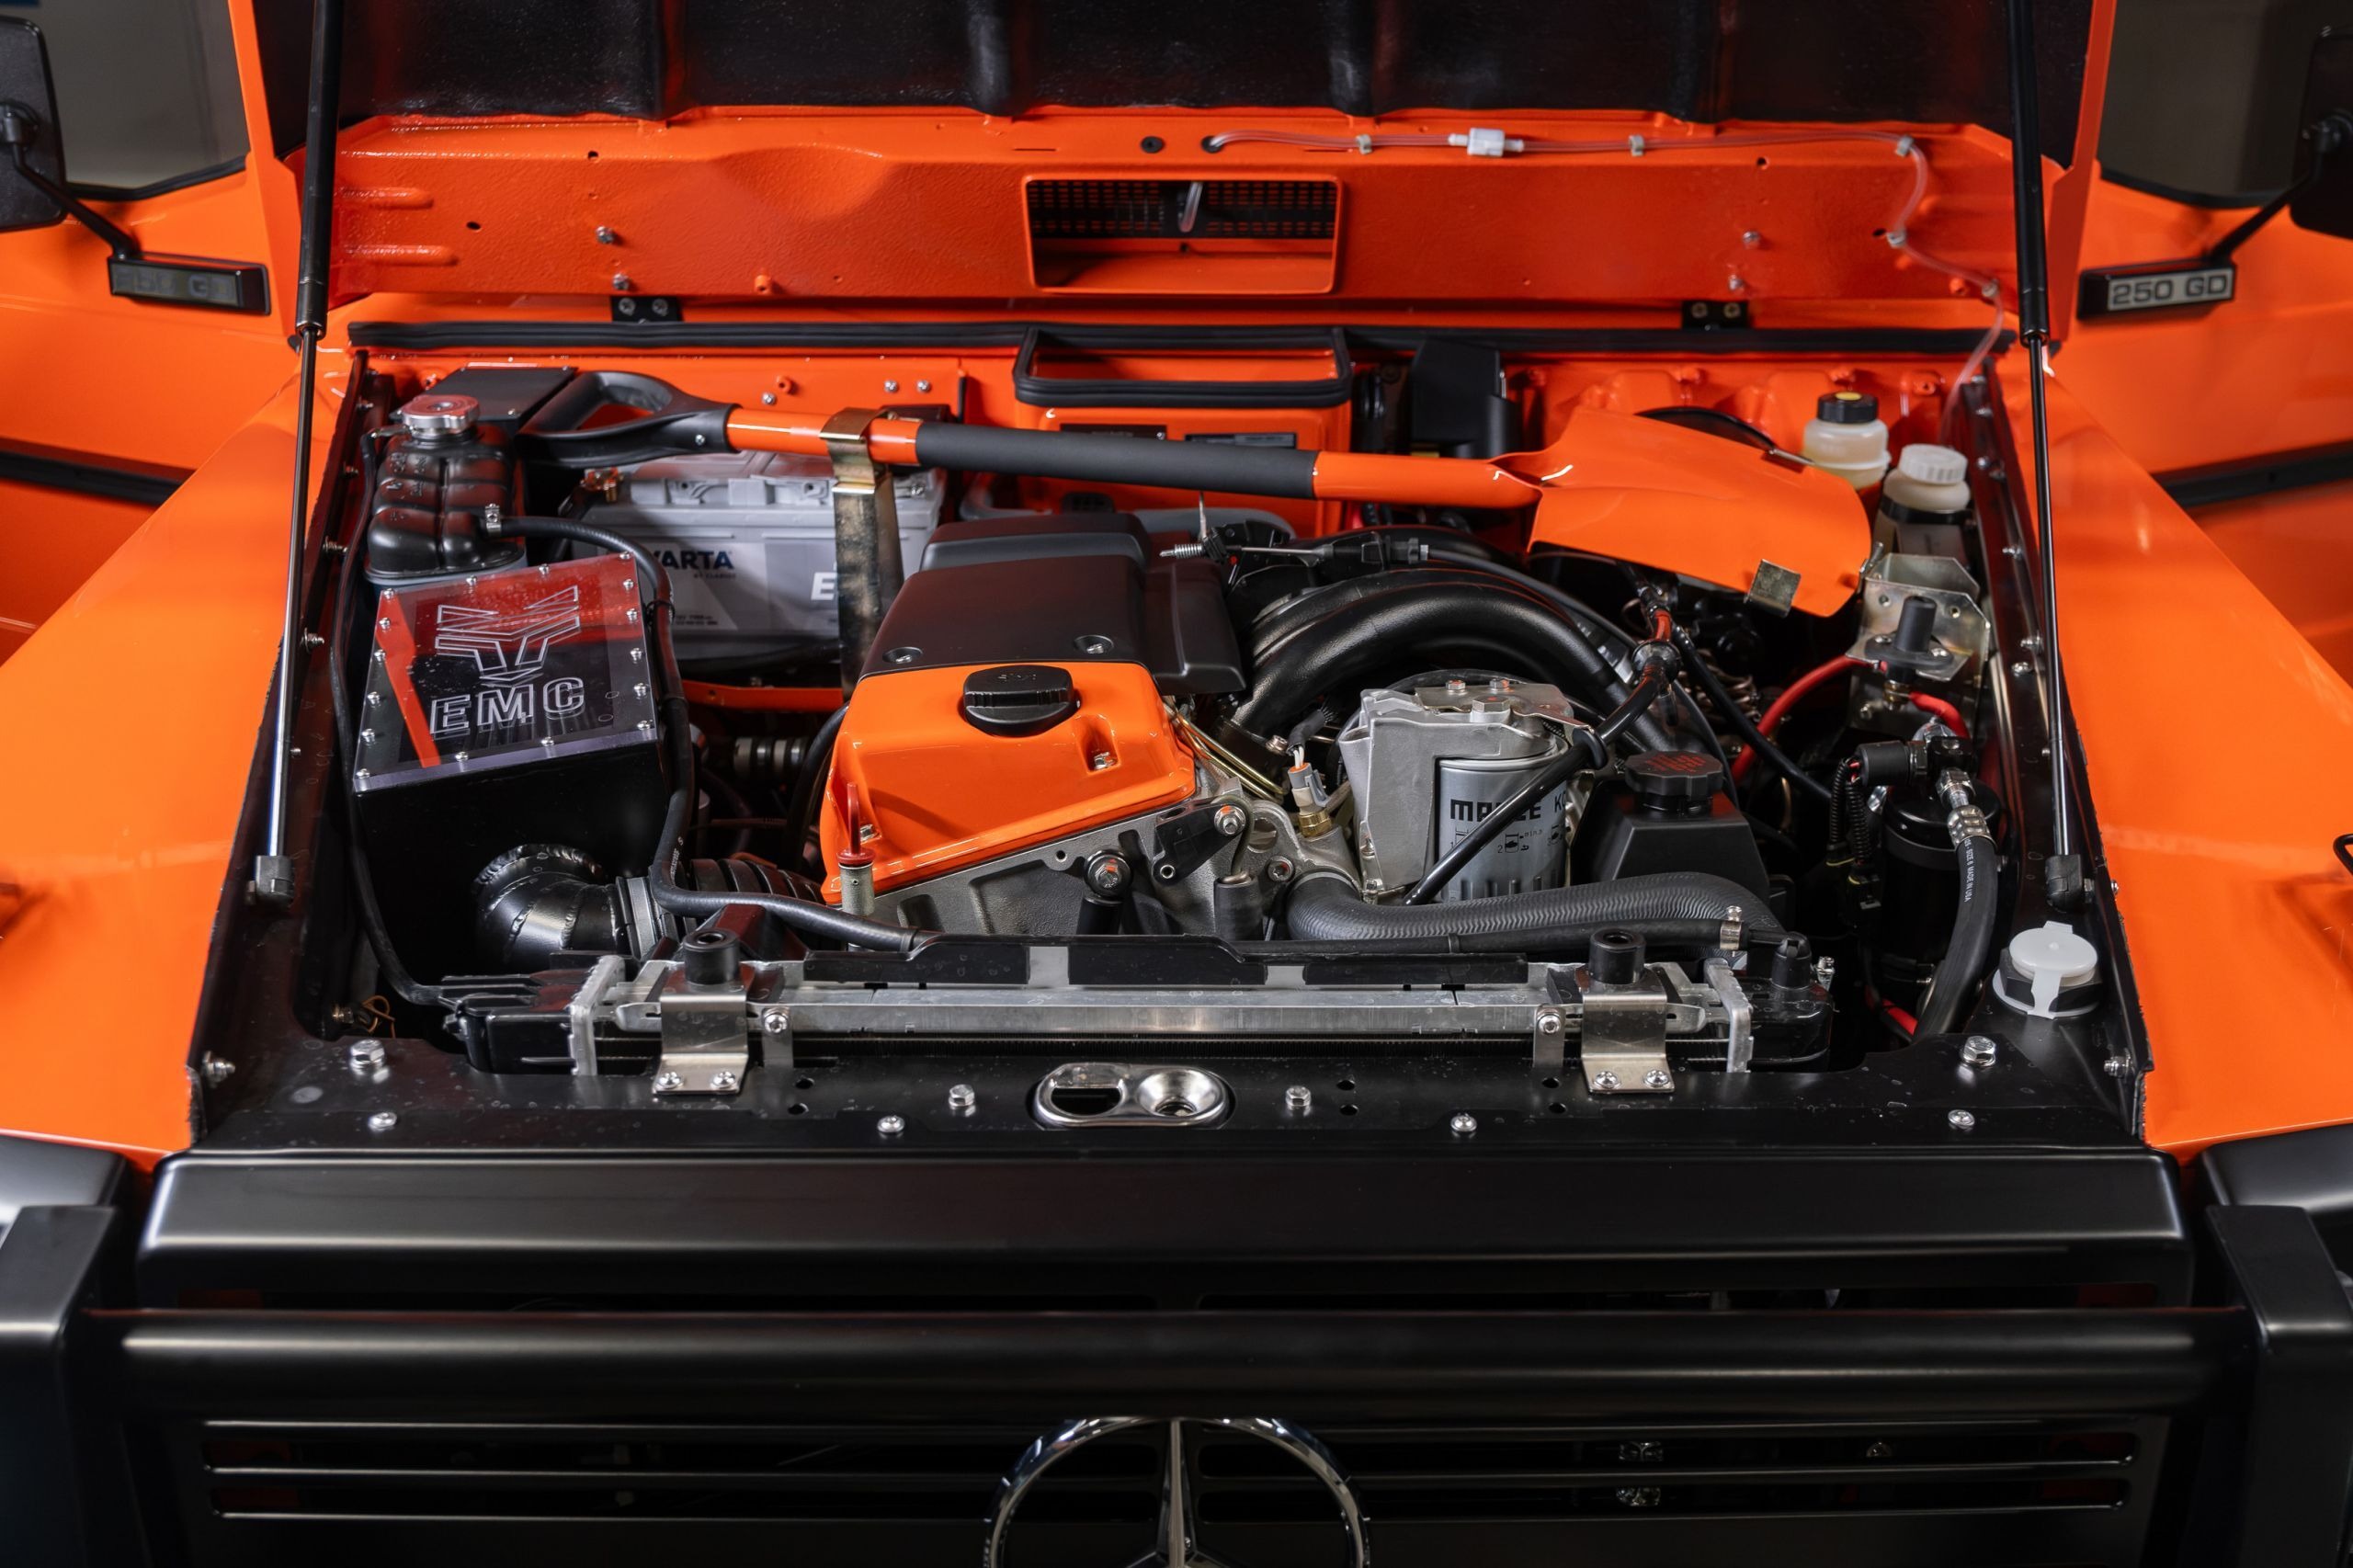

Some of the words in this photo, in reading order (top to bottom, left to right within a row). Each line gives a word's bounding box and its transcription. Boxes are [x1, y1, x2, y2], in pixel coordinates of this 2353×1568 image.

[2112, 279, 2174, 304] 250
[2185, 275, 2227, 297] GD
[429, 676, 585, 736] EMC
[1450, 799, 1541, 823] MAE
